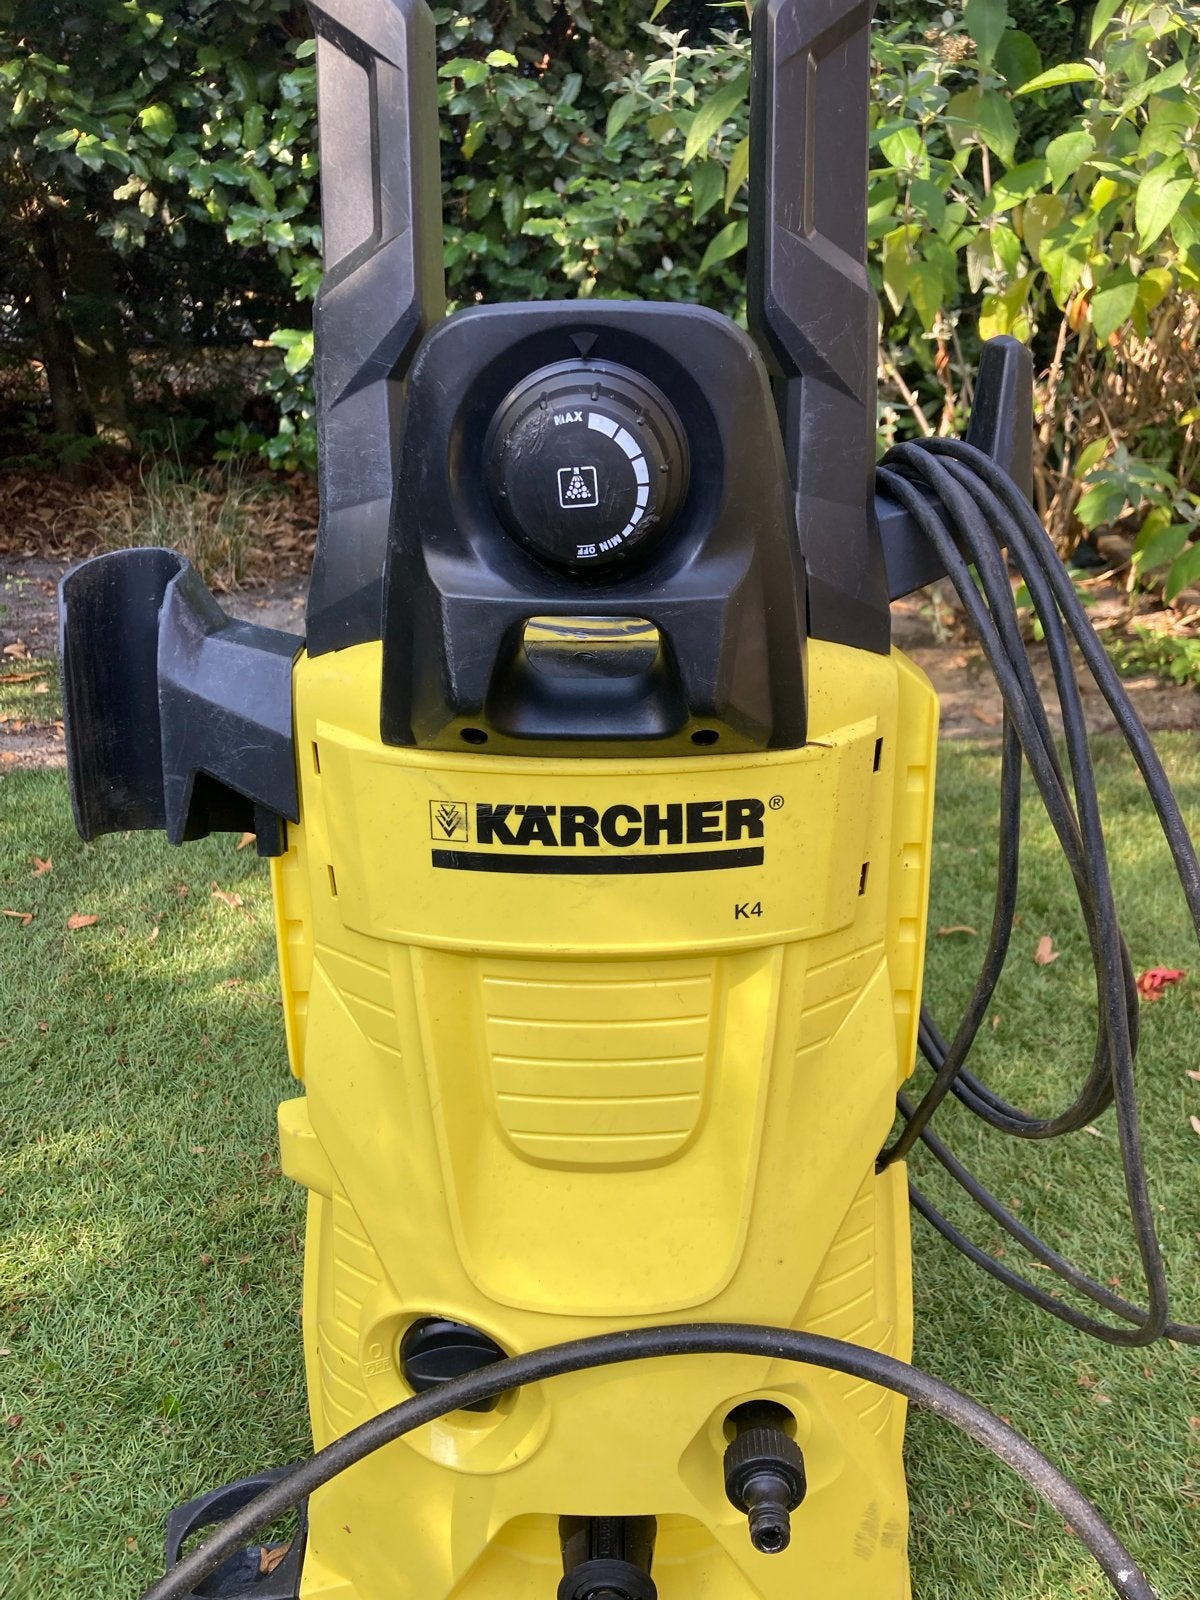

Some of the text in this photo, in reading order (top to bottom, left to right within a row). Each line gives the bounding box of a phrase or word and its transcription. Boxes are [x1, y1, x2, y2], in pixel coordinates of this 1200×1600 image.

[553, 411, 583, 426] MAX
[599, 533, 622, 552] MIN
[577, 545, 597, 556] OFF
[734, 902, 764, 920] K4
[366, 1360, 390, 1374] OFF
